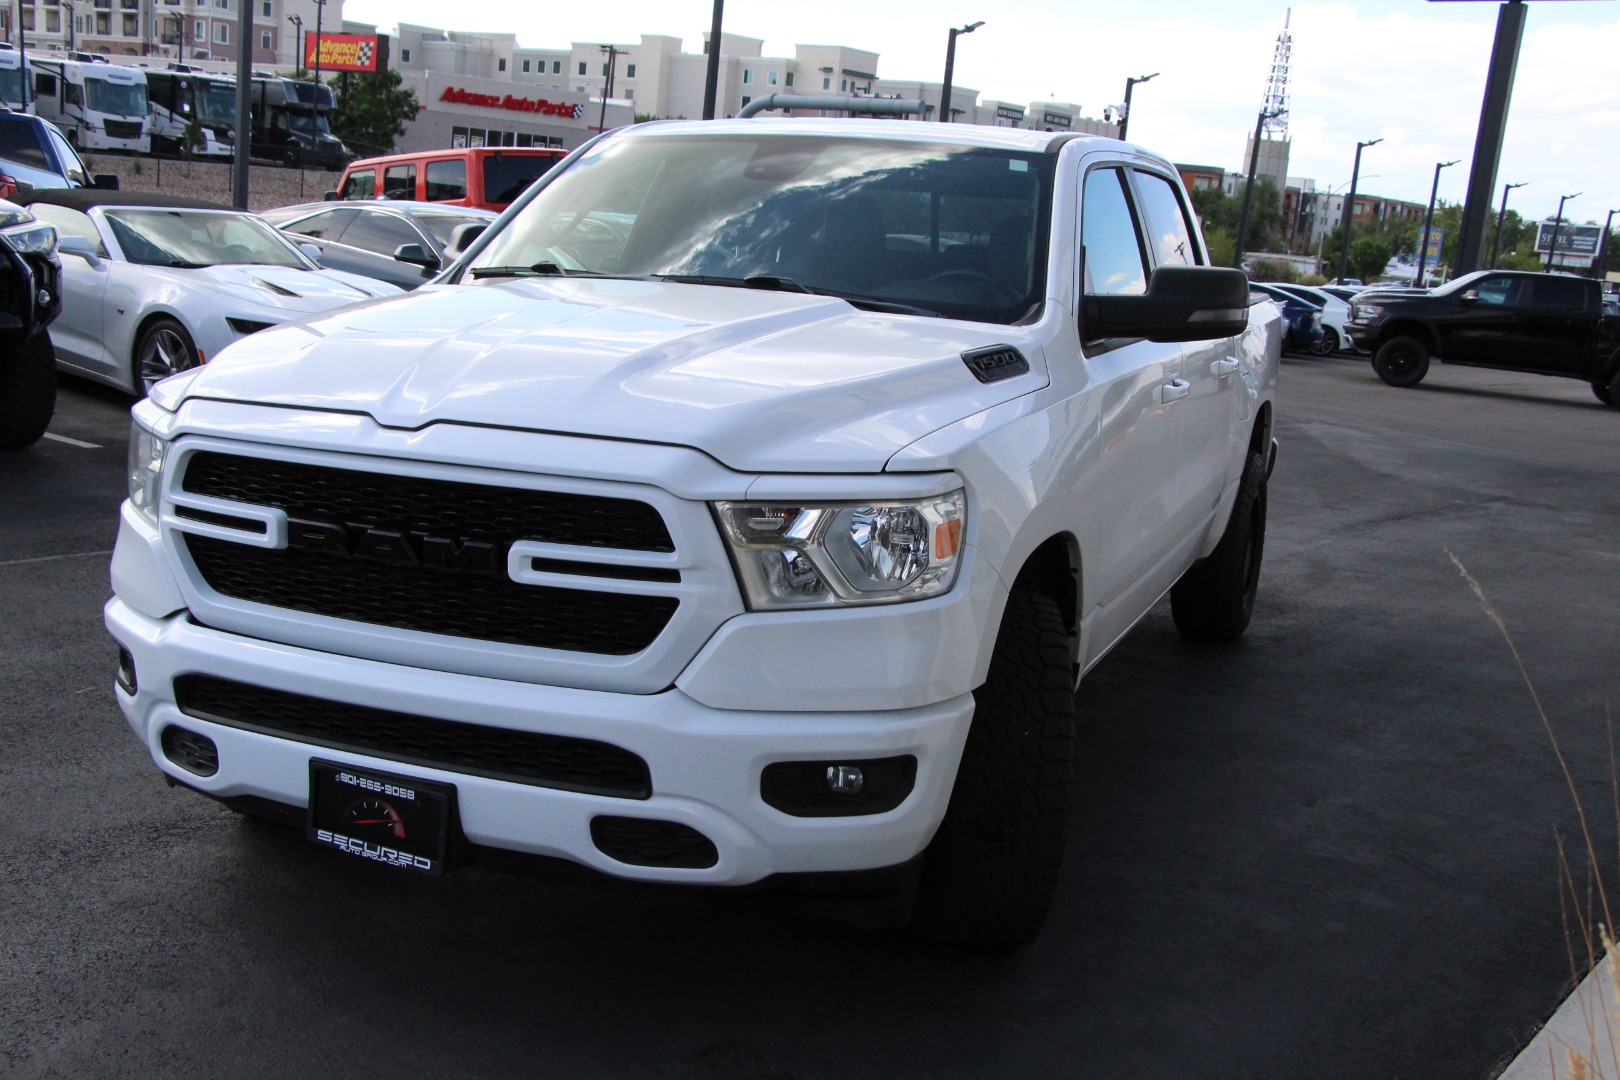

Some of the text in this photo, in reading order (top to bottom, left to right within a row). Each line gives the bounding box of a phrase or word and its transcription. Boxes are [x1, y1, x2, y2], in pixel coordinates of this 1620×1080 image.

[440, 86, 500, 108] Advance
[500, 94, 536, 112] Auto
[974, 351, 1017, 369] 1500
[286, 517, 497, 572] RAM
[340, 772, 415, 800] 801-265-9058
[317, 829, 431, 870] SECURED
[340, 845, 361, 855] AUTO
